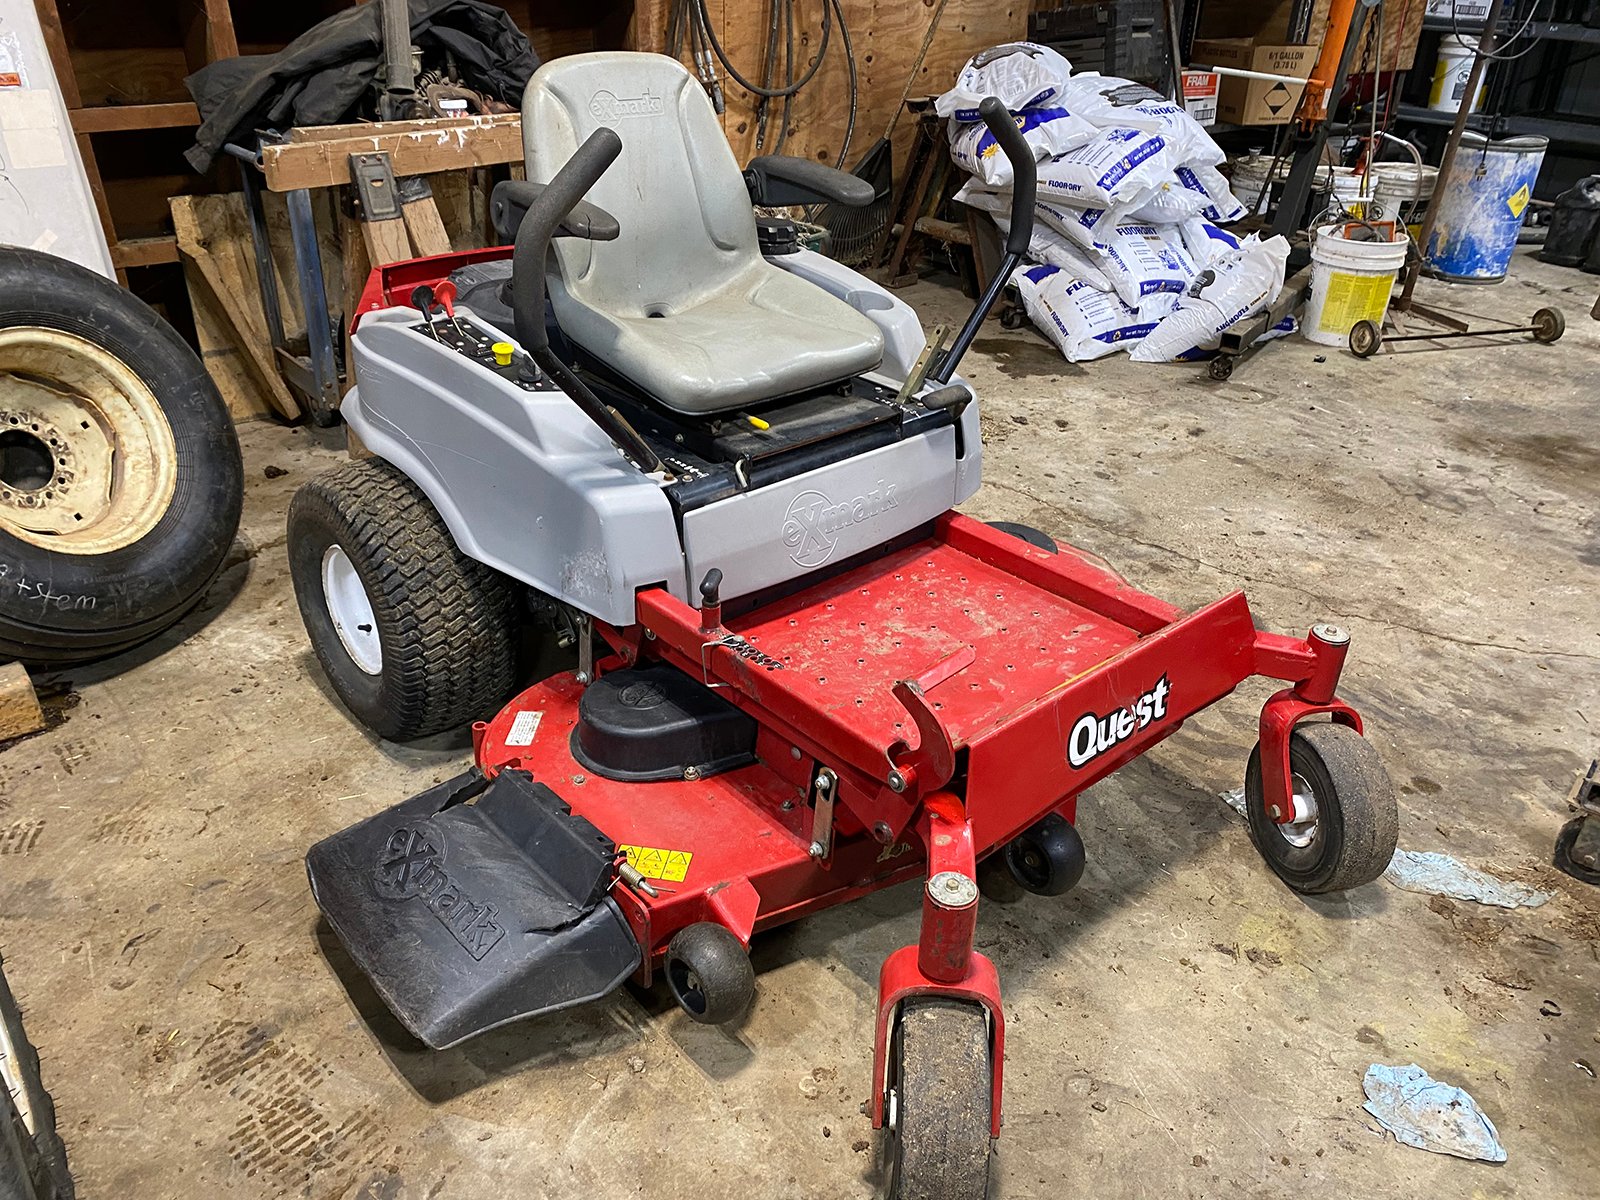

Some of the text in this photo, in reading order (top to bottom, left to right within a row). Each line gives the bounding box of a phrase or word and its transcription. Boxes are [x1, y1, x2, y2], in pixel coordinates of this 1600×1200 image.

[1279, 51, 1304, 60] GALLON
[1186, 75, 1209, 87] FRAM
[1068, 675, 1171, 768] Quest
